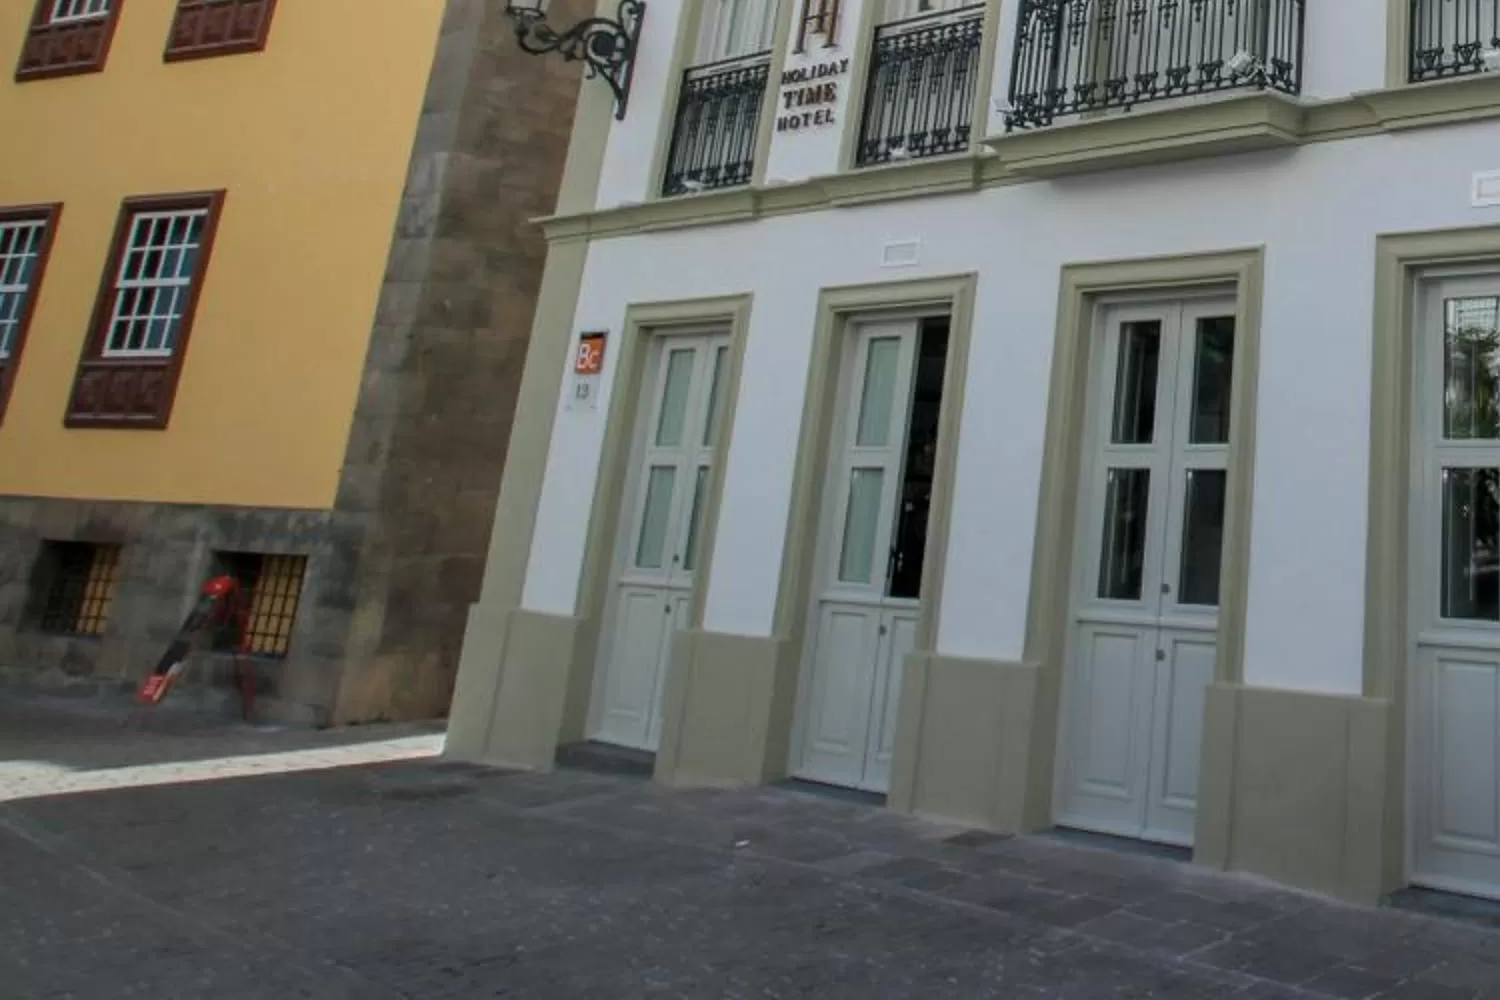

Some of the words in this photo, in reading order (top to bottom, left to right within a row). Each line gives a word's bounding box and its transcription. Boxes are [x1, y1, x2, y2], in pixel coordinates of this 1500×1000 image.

[781, 58, 849, 84] HOLIDAY
[783, 82, 837, 109] TIME
[777, 109, 836, 132] HOTEL
